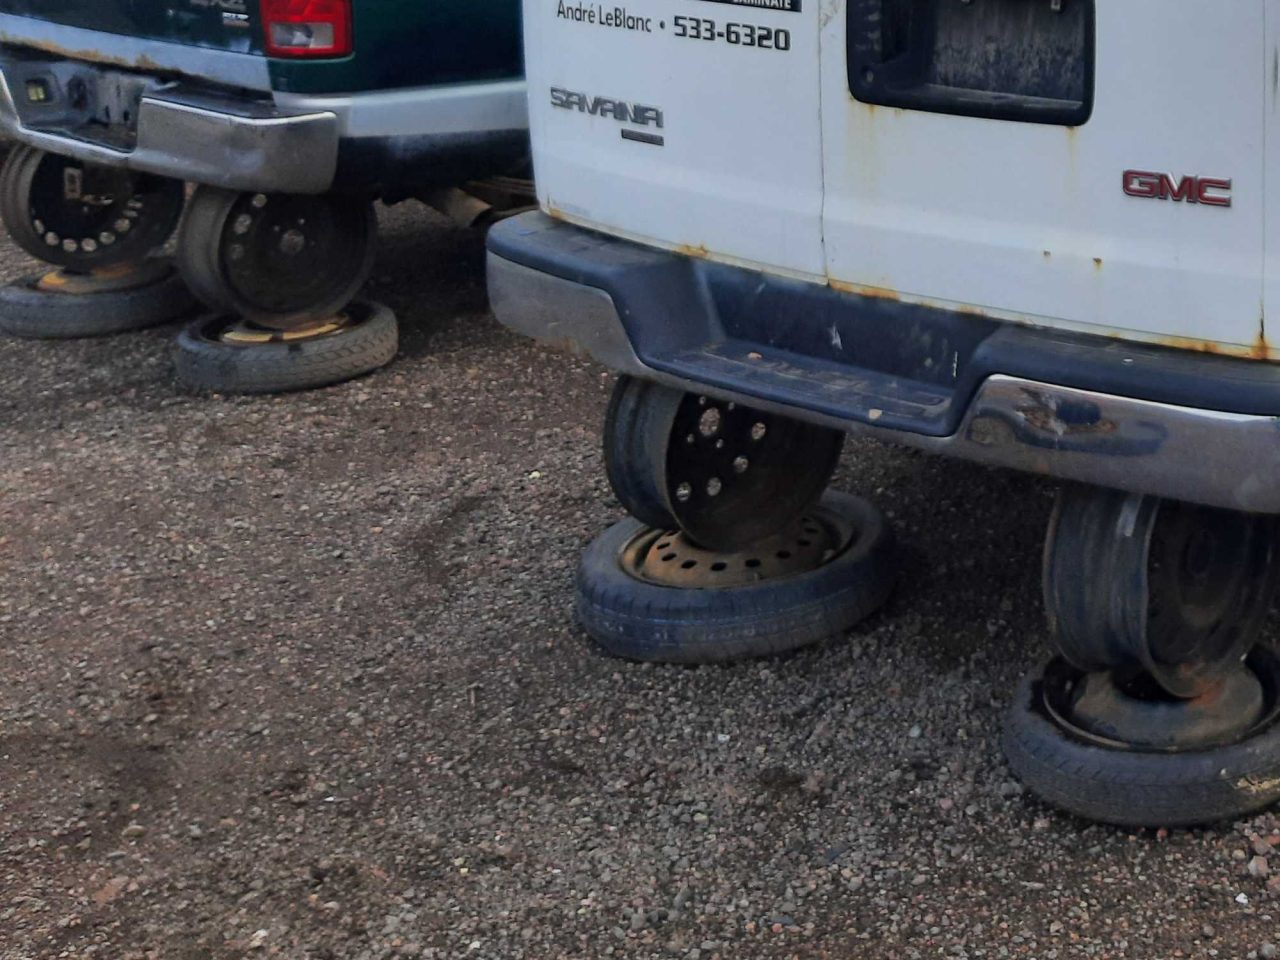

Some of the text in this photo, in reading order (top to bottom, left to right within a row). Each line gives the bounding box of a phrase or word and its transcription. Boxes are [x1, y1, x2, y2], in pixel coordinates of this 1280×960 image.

[557, 0, 791, 51] André LeBlanc 533-6320
[550, 86, 664, 128] SAVANA
[1121, 169, 1232, 208] GMC
